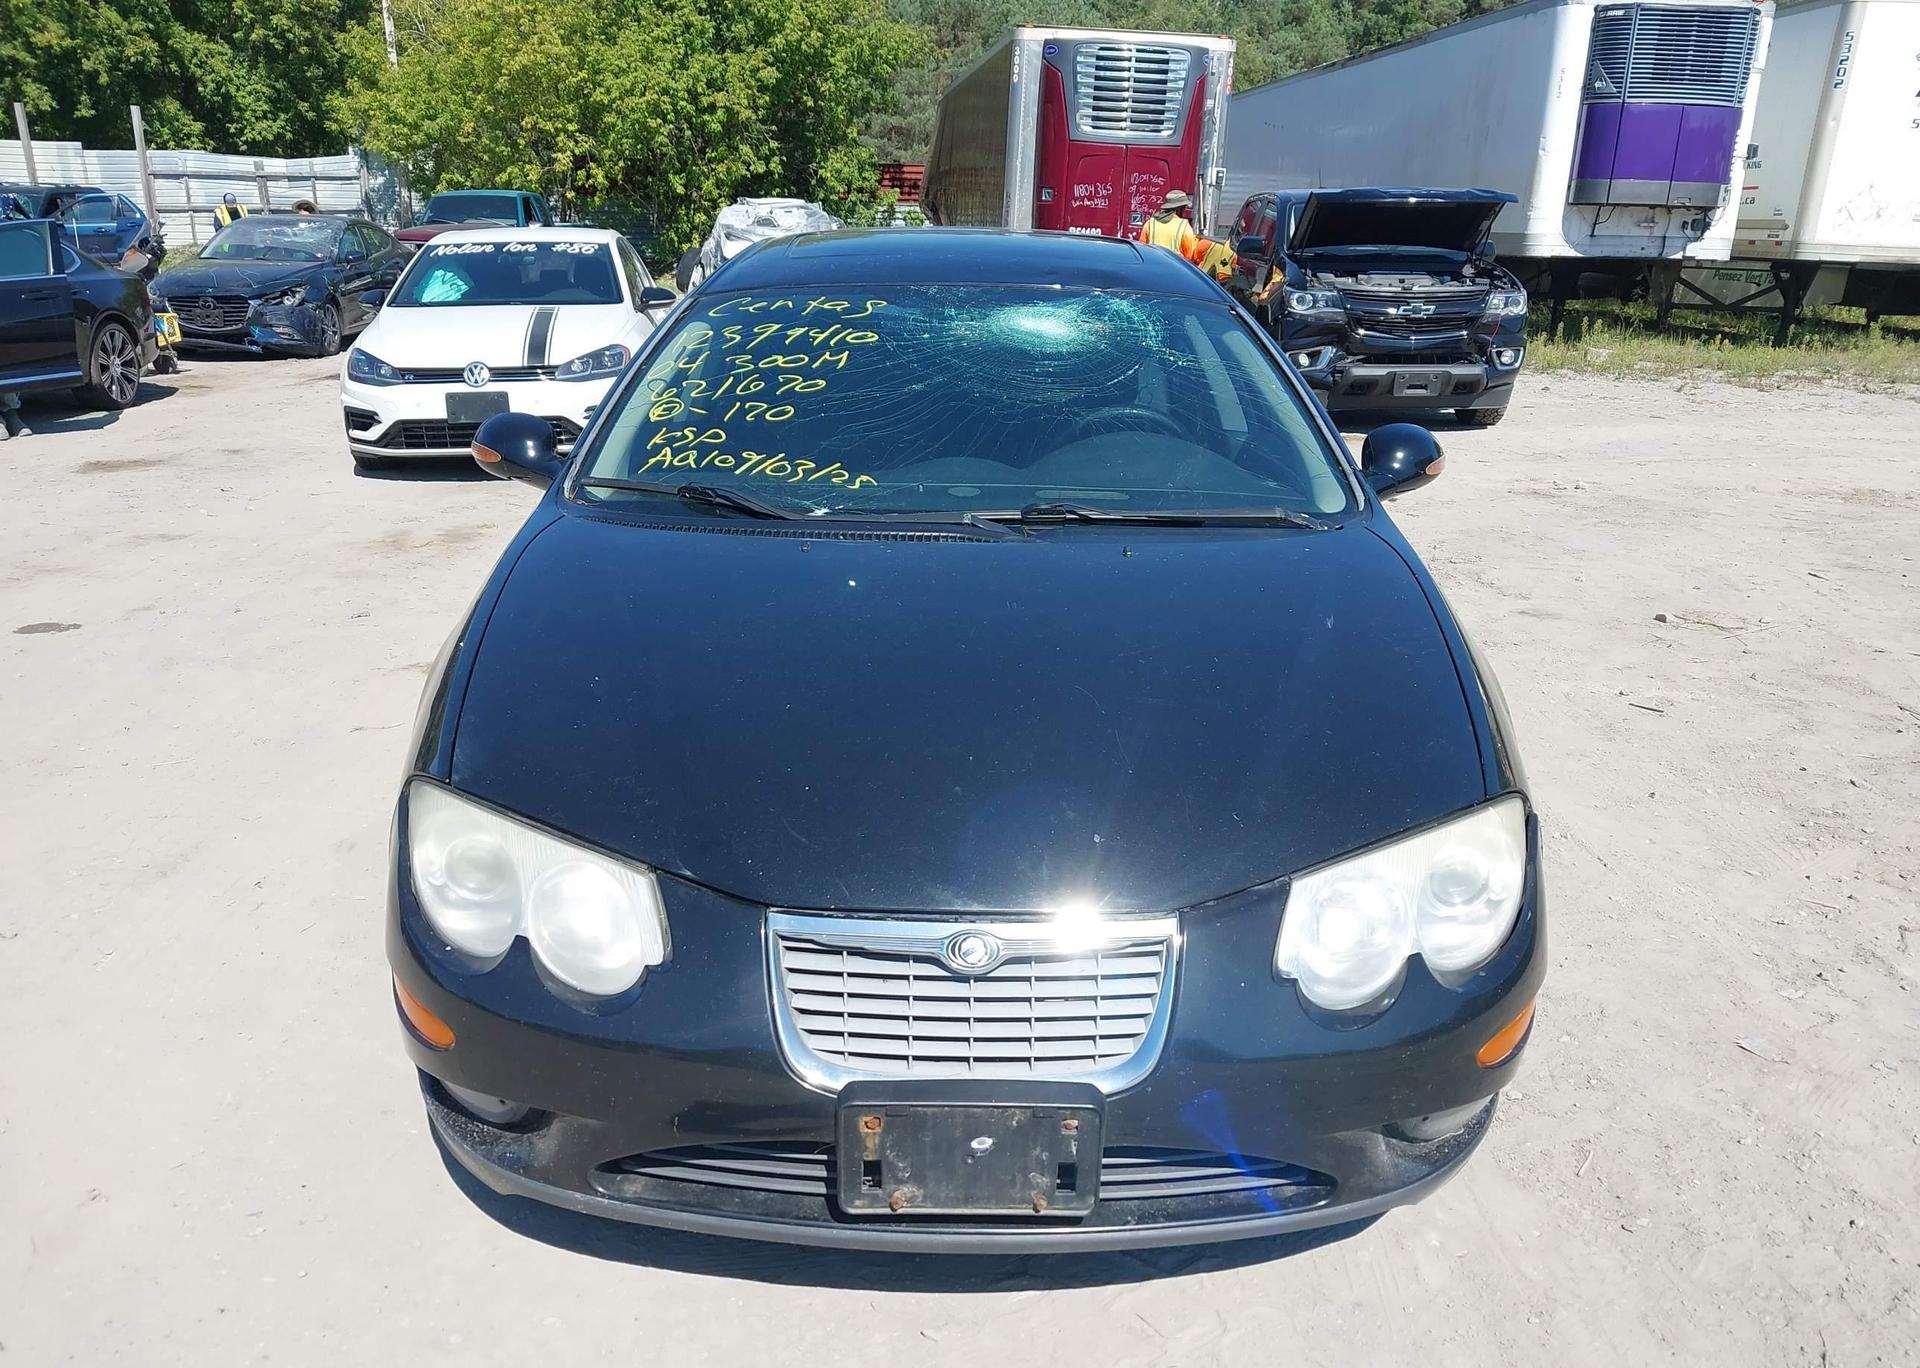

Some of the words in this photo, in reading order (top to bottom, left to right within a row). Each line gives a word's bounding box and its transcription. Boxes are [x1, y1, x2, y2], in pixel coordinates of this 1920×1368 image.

[1833, 31, 1855, 89] 53202
[1746, 161, 1762, 169] KING
[430, 242, 495, 257] Nolan
[551, 242, 599, 254] #86
[1712, 270, 1743, 281] Pensez
[725, 350, 850, 374] 300M
